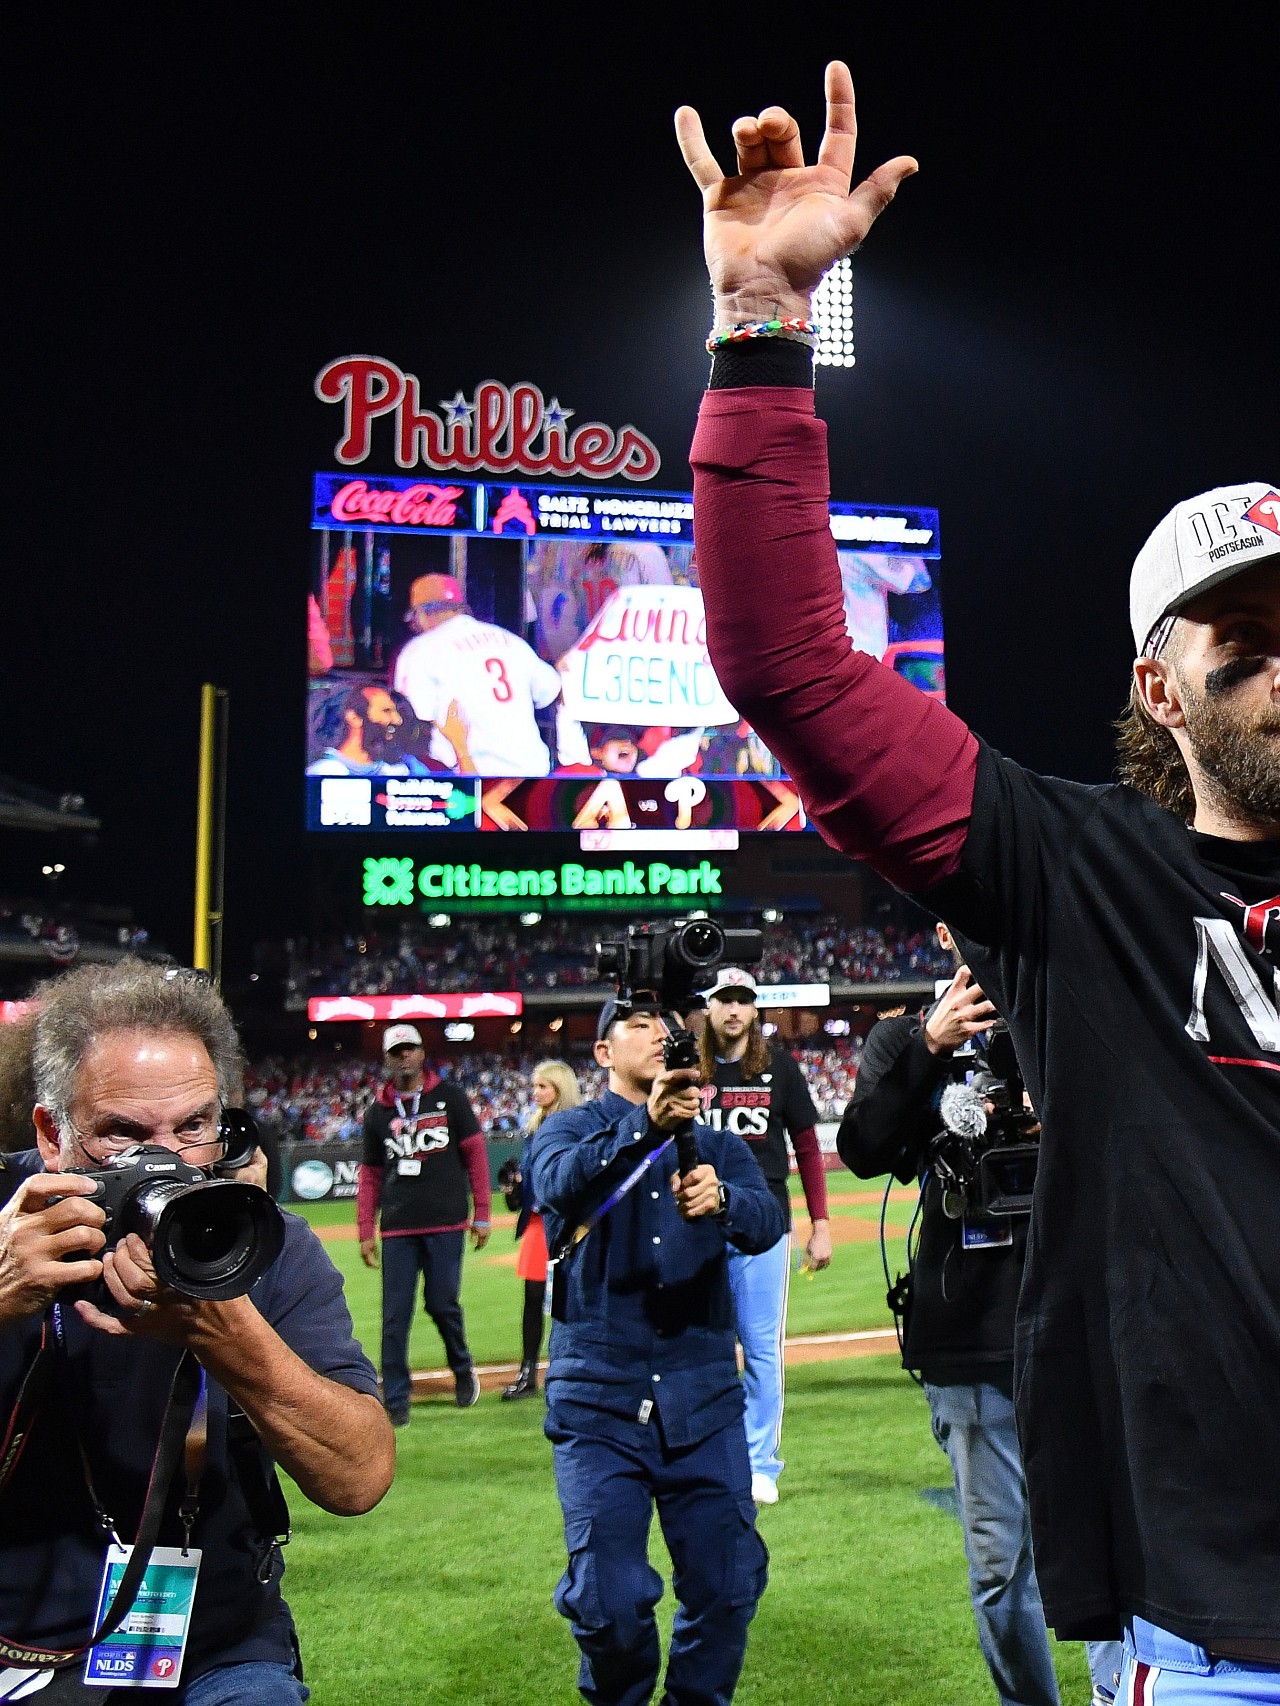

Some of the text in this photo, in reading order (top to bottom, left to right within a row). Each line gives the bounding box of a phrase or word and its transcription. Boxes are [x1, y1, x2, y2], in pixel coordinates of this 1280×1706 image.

[315, 355, 661, 480] Phillies
[538, 512, 682, 534] TRIAL LAWYERS
[1208, 535, 1264, 563] POSTSEASON
[485, 658, 512, 704] 3
[582, 651, 716, 707] L3GEND
[418, 861, 722, 897] Citizens Bank Park
[383, 1126, 450, 1160] NLCS
[144, 1163, 177, 1172] Canon
[95, 1659, 134, 1671] NLDS
